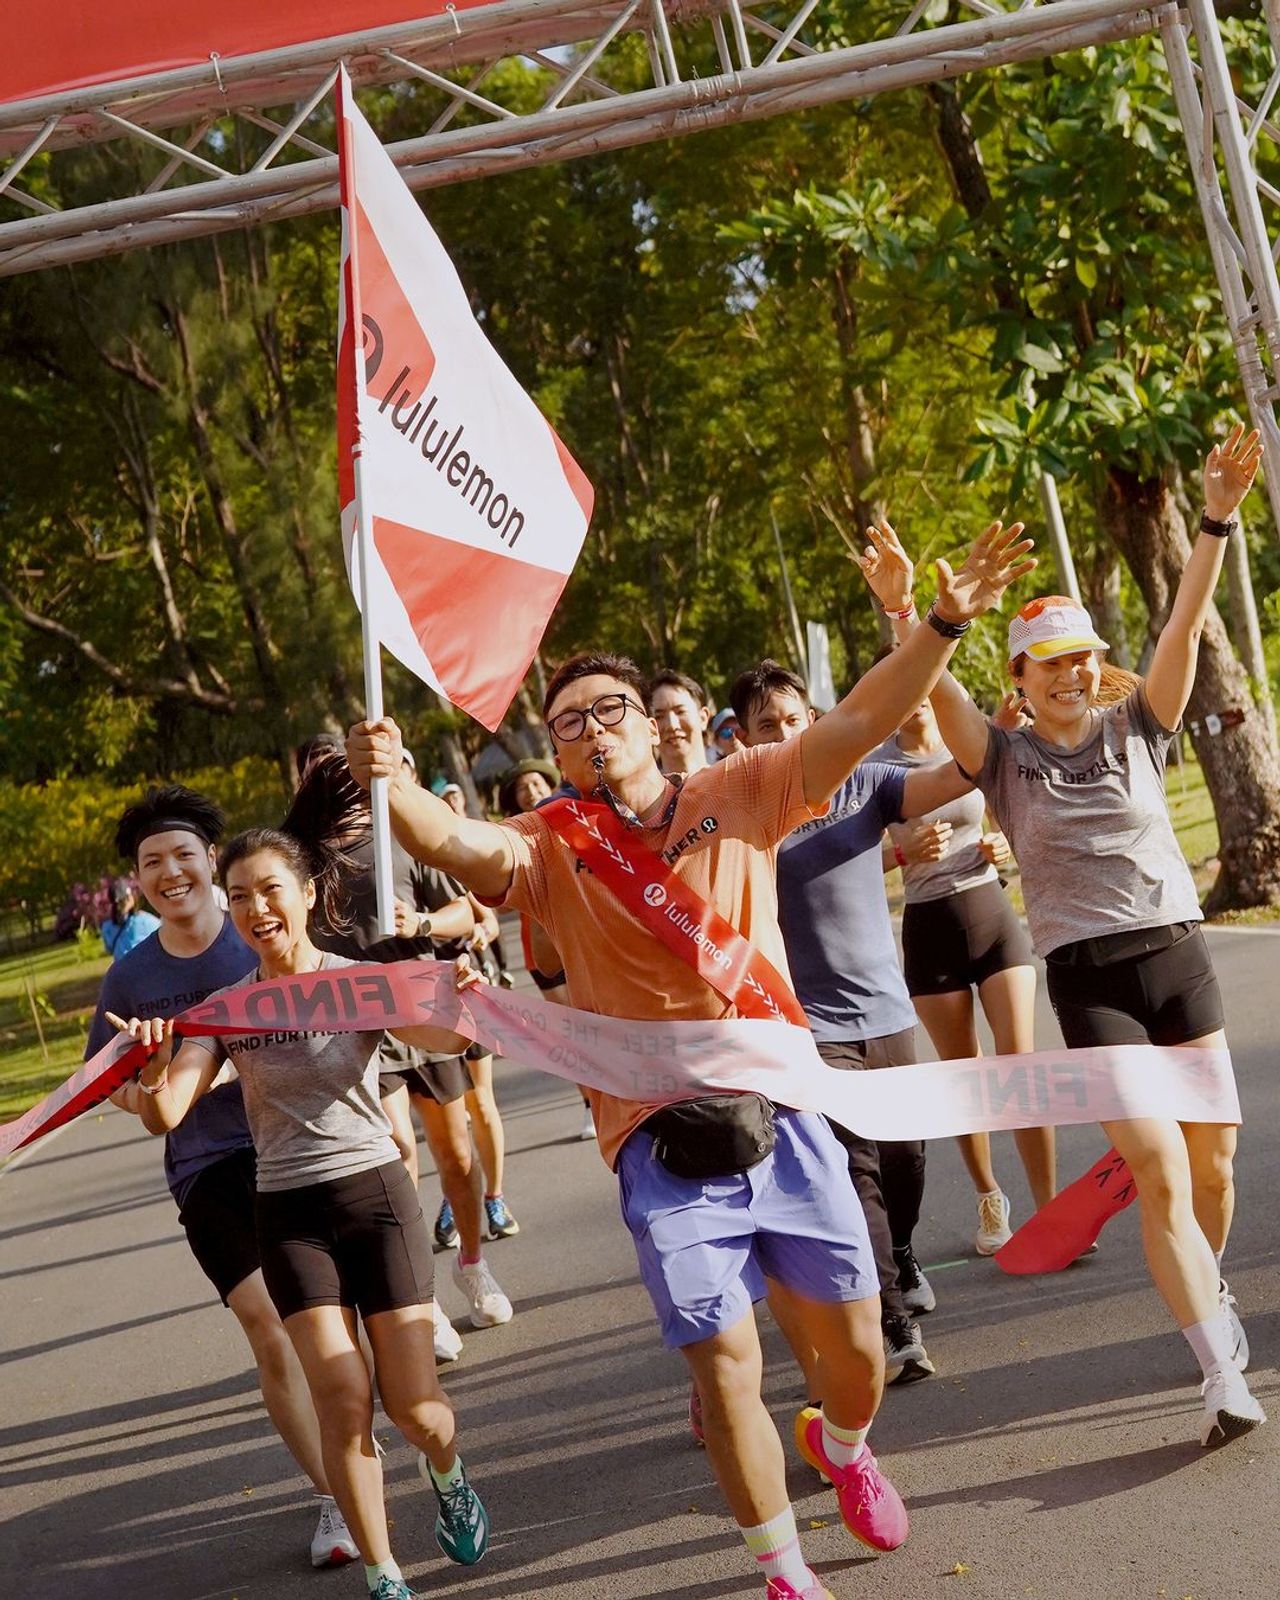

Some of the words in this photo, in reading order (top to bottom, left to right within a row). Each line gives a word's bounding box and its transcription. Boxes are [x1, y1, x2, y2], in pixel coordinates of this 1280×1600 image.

[377, 365, 525, 549] lululemon
[663, 900, 733, 971] lululemon
[227, 1036, 260, 1056] FIND
